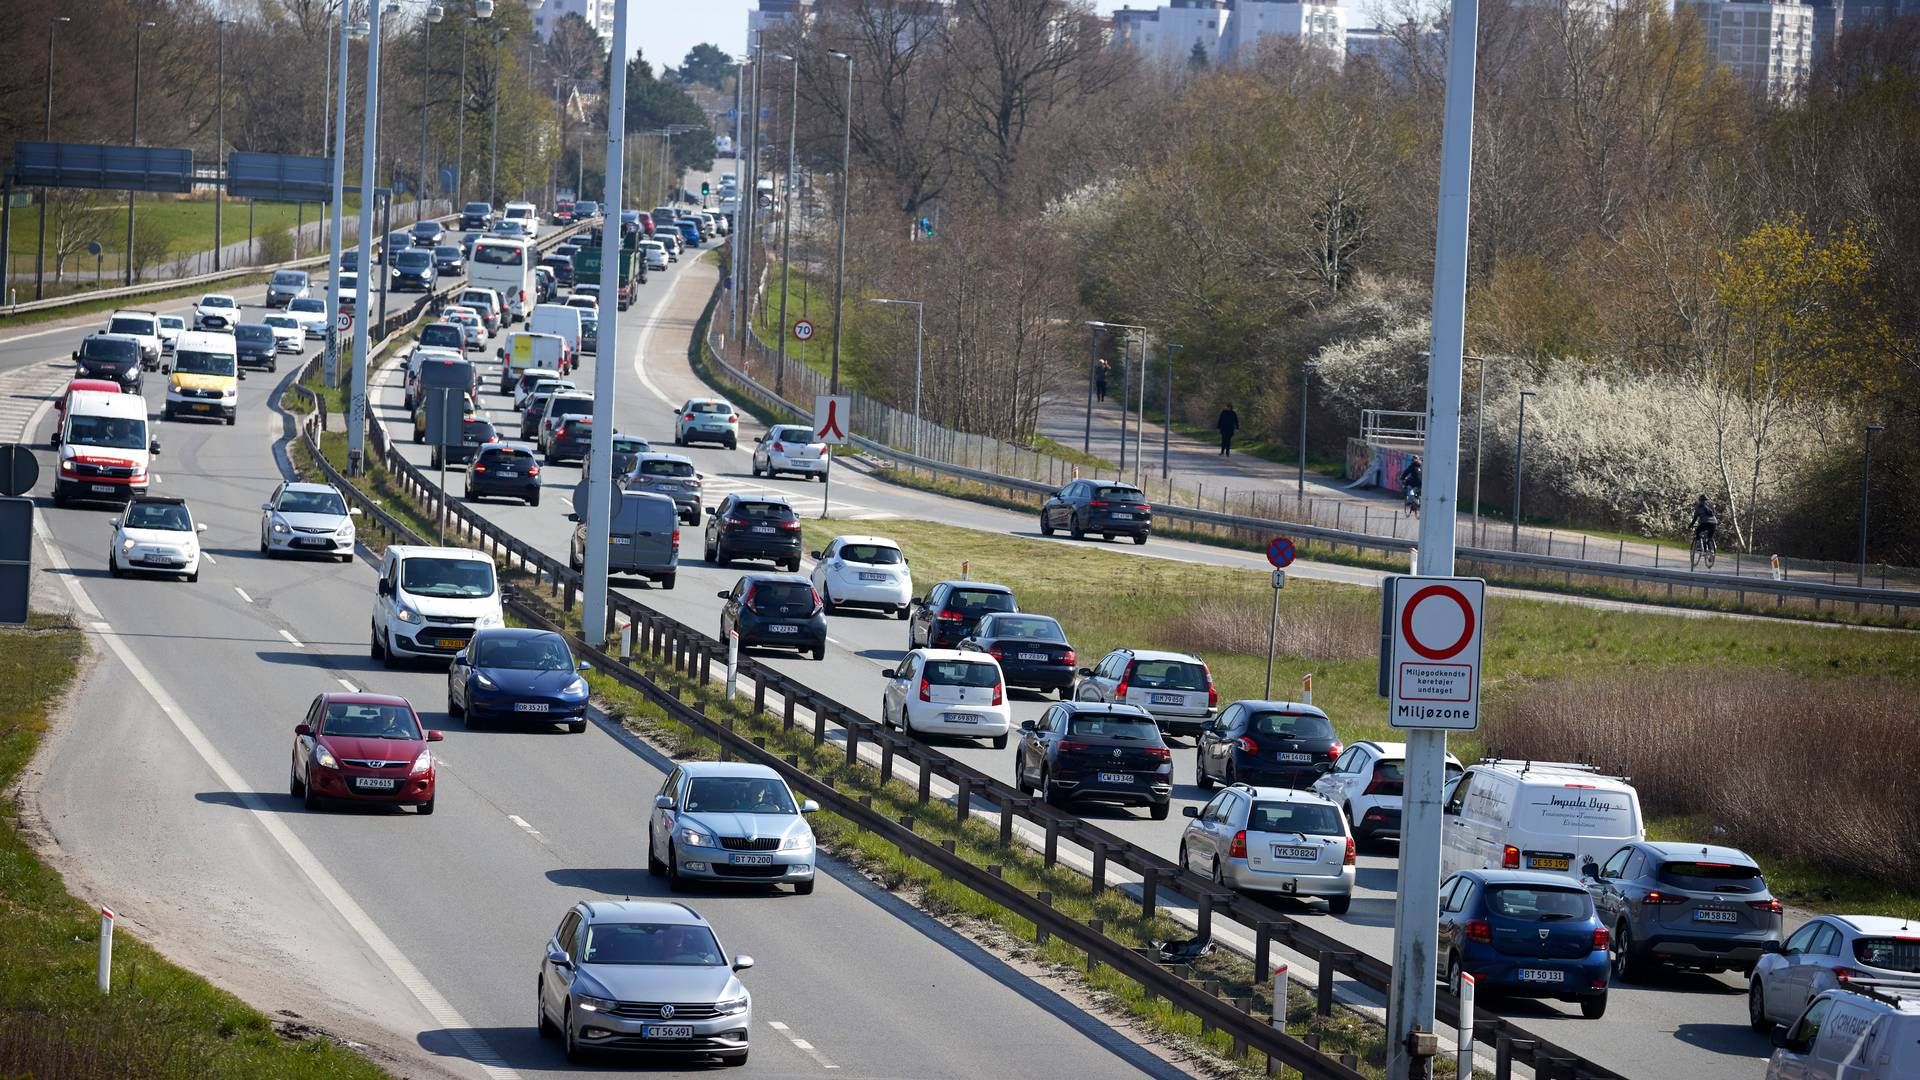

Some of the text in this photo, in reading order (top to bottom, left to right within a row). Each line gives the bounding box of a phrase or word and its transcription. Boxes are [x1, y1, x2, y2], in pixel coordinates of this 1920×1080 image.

[797, 326, 811, 335] 70
[1406, 669, 1466, 679] Miljøgodkendte
[1417, 678, 1453, 687] køretøjer
[1418, 687, 1452, 695] undtaget
[1398, 705, 1470, 720] Miljøzone
[369, 779, 378, 787] 29
[1550, 795, 1610, 812] Impala Byg
[1277, 847, 1315, 857] YK 30 824
[735, 855, 771, 864] BT 70 200
[1532, 858, 1568, 868] DE 55 199
[1721, 912, 1736, 920] 828
[1524, 970, 1561, 980] BT 50 131
[648, 1027, 690, 1037] CT 56 491
